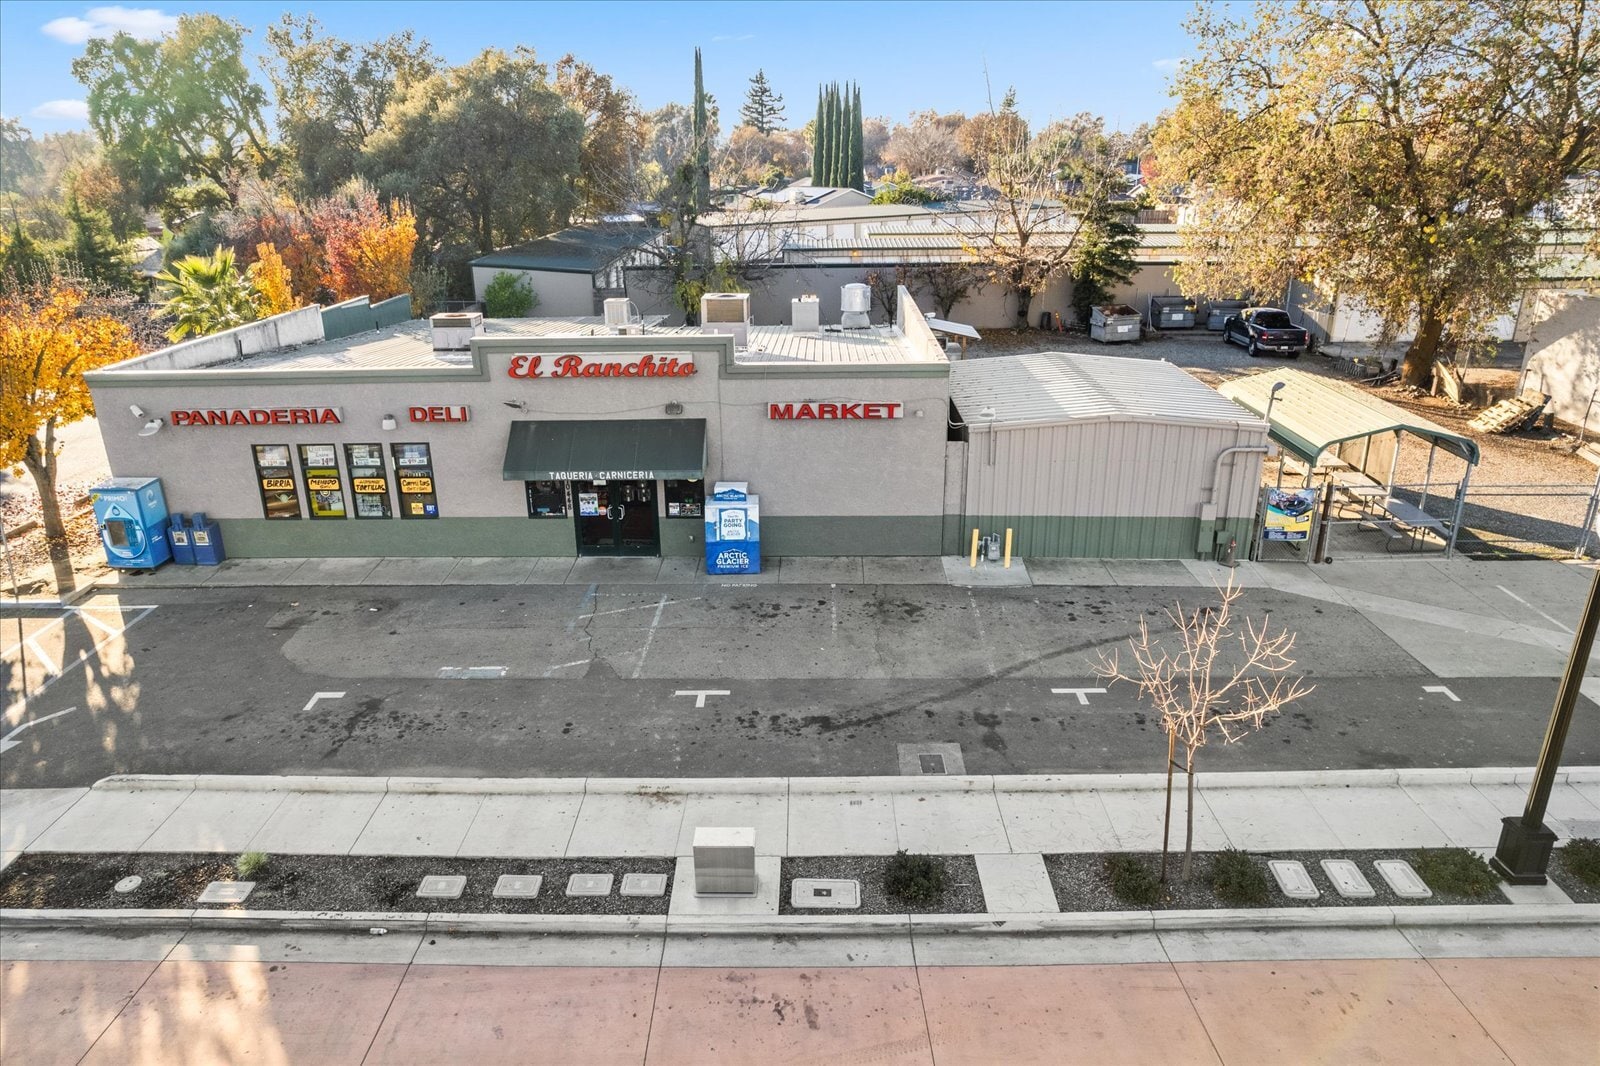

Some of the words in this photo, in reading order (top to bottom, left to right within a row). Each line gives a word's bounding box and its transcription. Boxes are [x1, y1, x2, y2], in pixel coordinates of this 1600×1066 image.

[508, 355, 543, 378] El
[551, 354, 698, 378] Ranchito
[171, 409, 341, 425] PANADERIA
[409, 406, 468, 422] DELI
[770, 403, 902, 420] MARKET
[266, 479, 292, 488] BIRRIA
[549, 471, 593, 480] TAQUERIA
[599, 471, 655, 480] CARNICERIA
